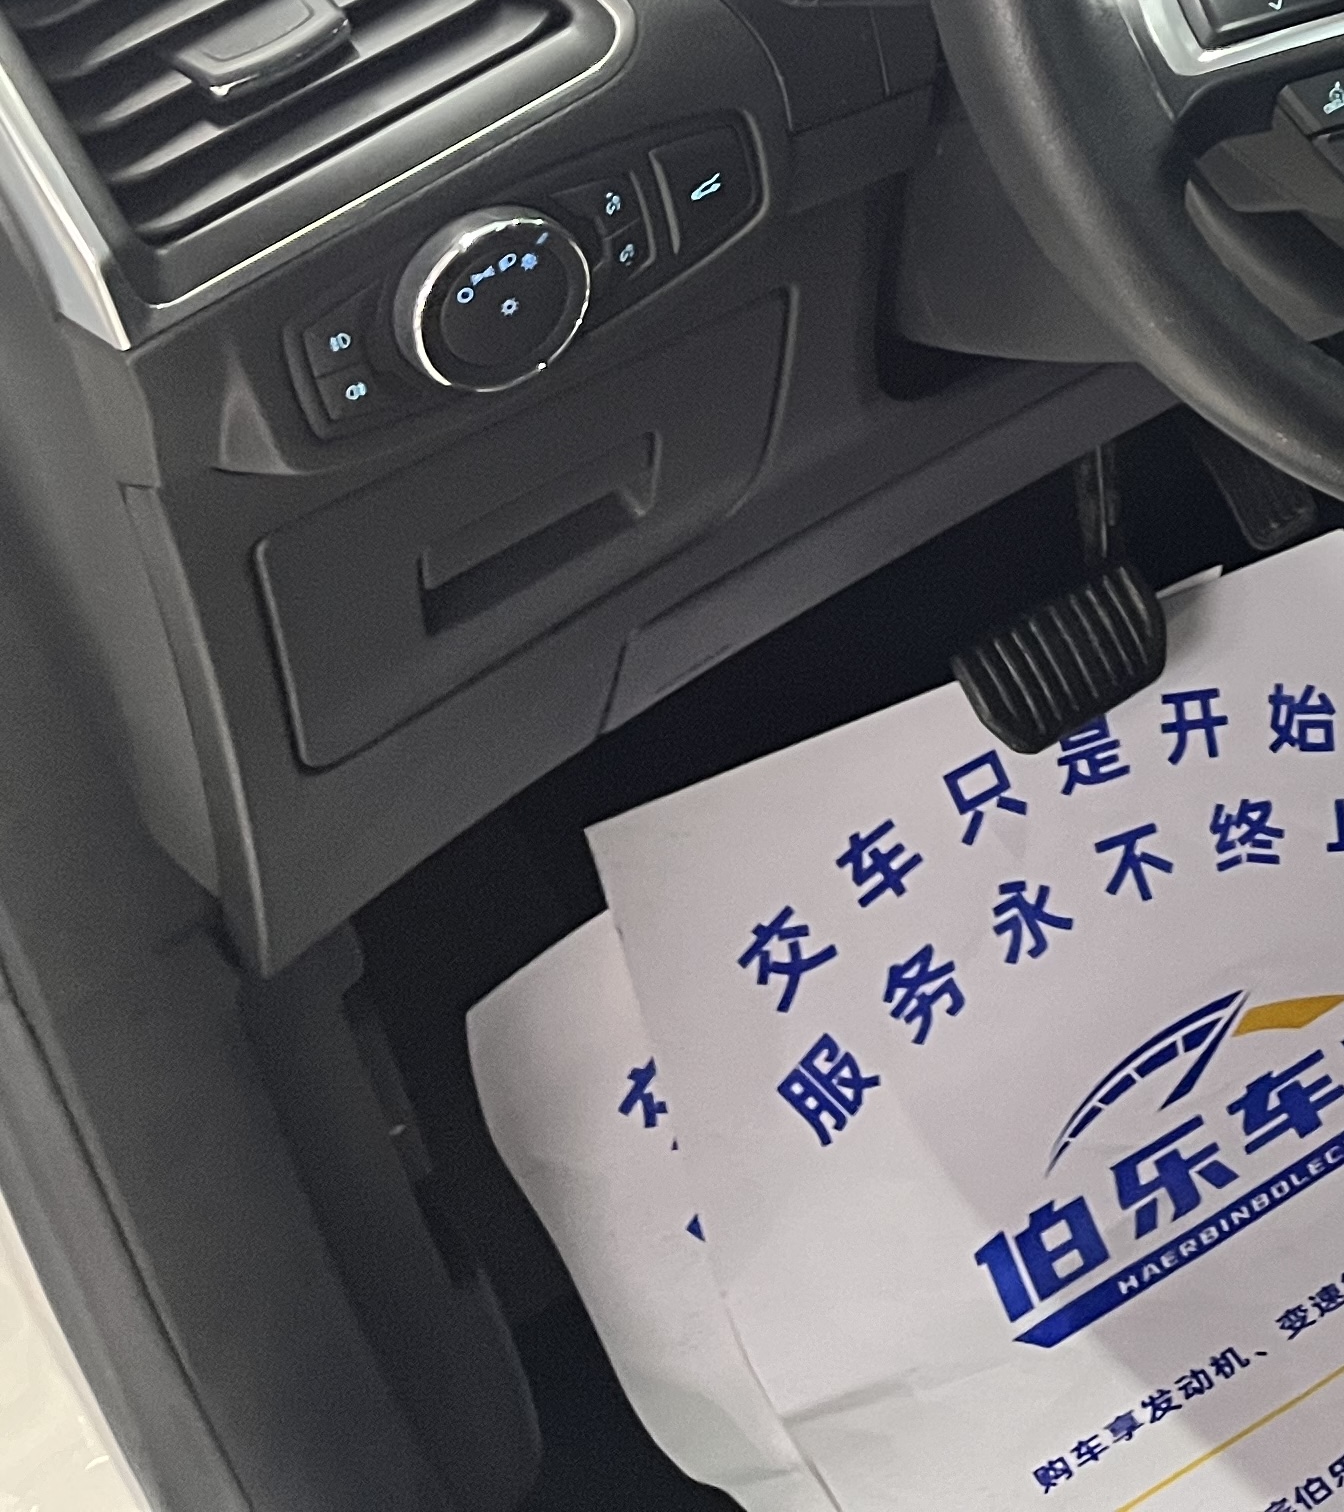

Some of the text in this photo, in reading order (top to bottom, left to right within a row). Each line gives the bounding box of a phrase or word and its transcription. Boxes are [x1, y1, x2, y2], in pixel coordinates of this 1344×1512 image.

[738, 683, 1336, 1013] 交车只是开始
